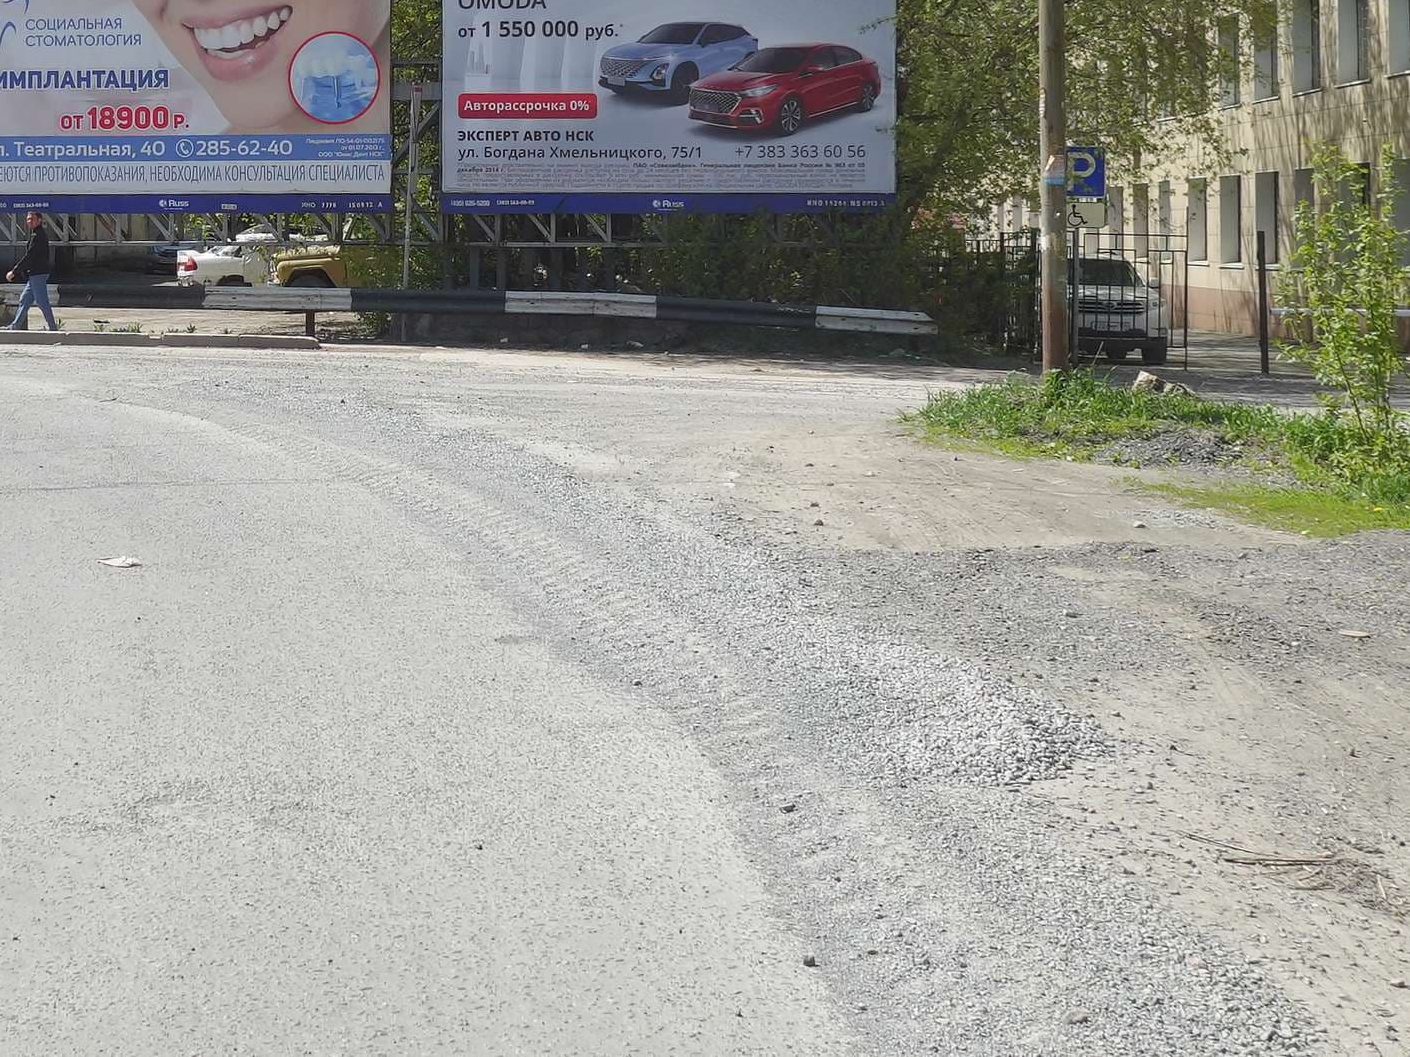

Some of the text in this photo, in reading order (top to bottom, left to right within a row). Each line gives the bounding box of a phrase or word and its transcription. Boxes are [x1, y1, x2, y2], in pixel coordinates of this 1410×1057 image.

[25, 17, 122, 32] СОЦИАЛЬНАЯ
[458, 21, 619, 40] от 1 550 000 руб.
[25, 33, 142, 47] СТОМАТОЛОГИЯ
[464, 100, 590, 113] Авторассрочка 0%
[87, 106, 170, 130] 18900
[457, 130, 594, 142] ЭКСПЕРТ АВТО НСК
[13, 142, 137, 160] Театральная,
[140, 141, 166, 156] 40
[196, 140, 293, 156] 285-62-40
[458, 146, 702, 161] ул. Богдана Хмельницкого, 75/1
[735, 145, 866, 158] +7 383 363 60 56
[34, 165, 148, 184] ПРОТИВОПОКАЗАНИЯ,
[149, 165, 222, 183] НЕОБХОДИМА
[225, 165, 306, 183] КОНСУЛЬТАЦИЯ
[308, 164, 385, 182] СПЕЦИАЛИСТА
[168, 199, 189, 207] Russ
